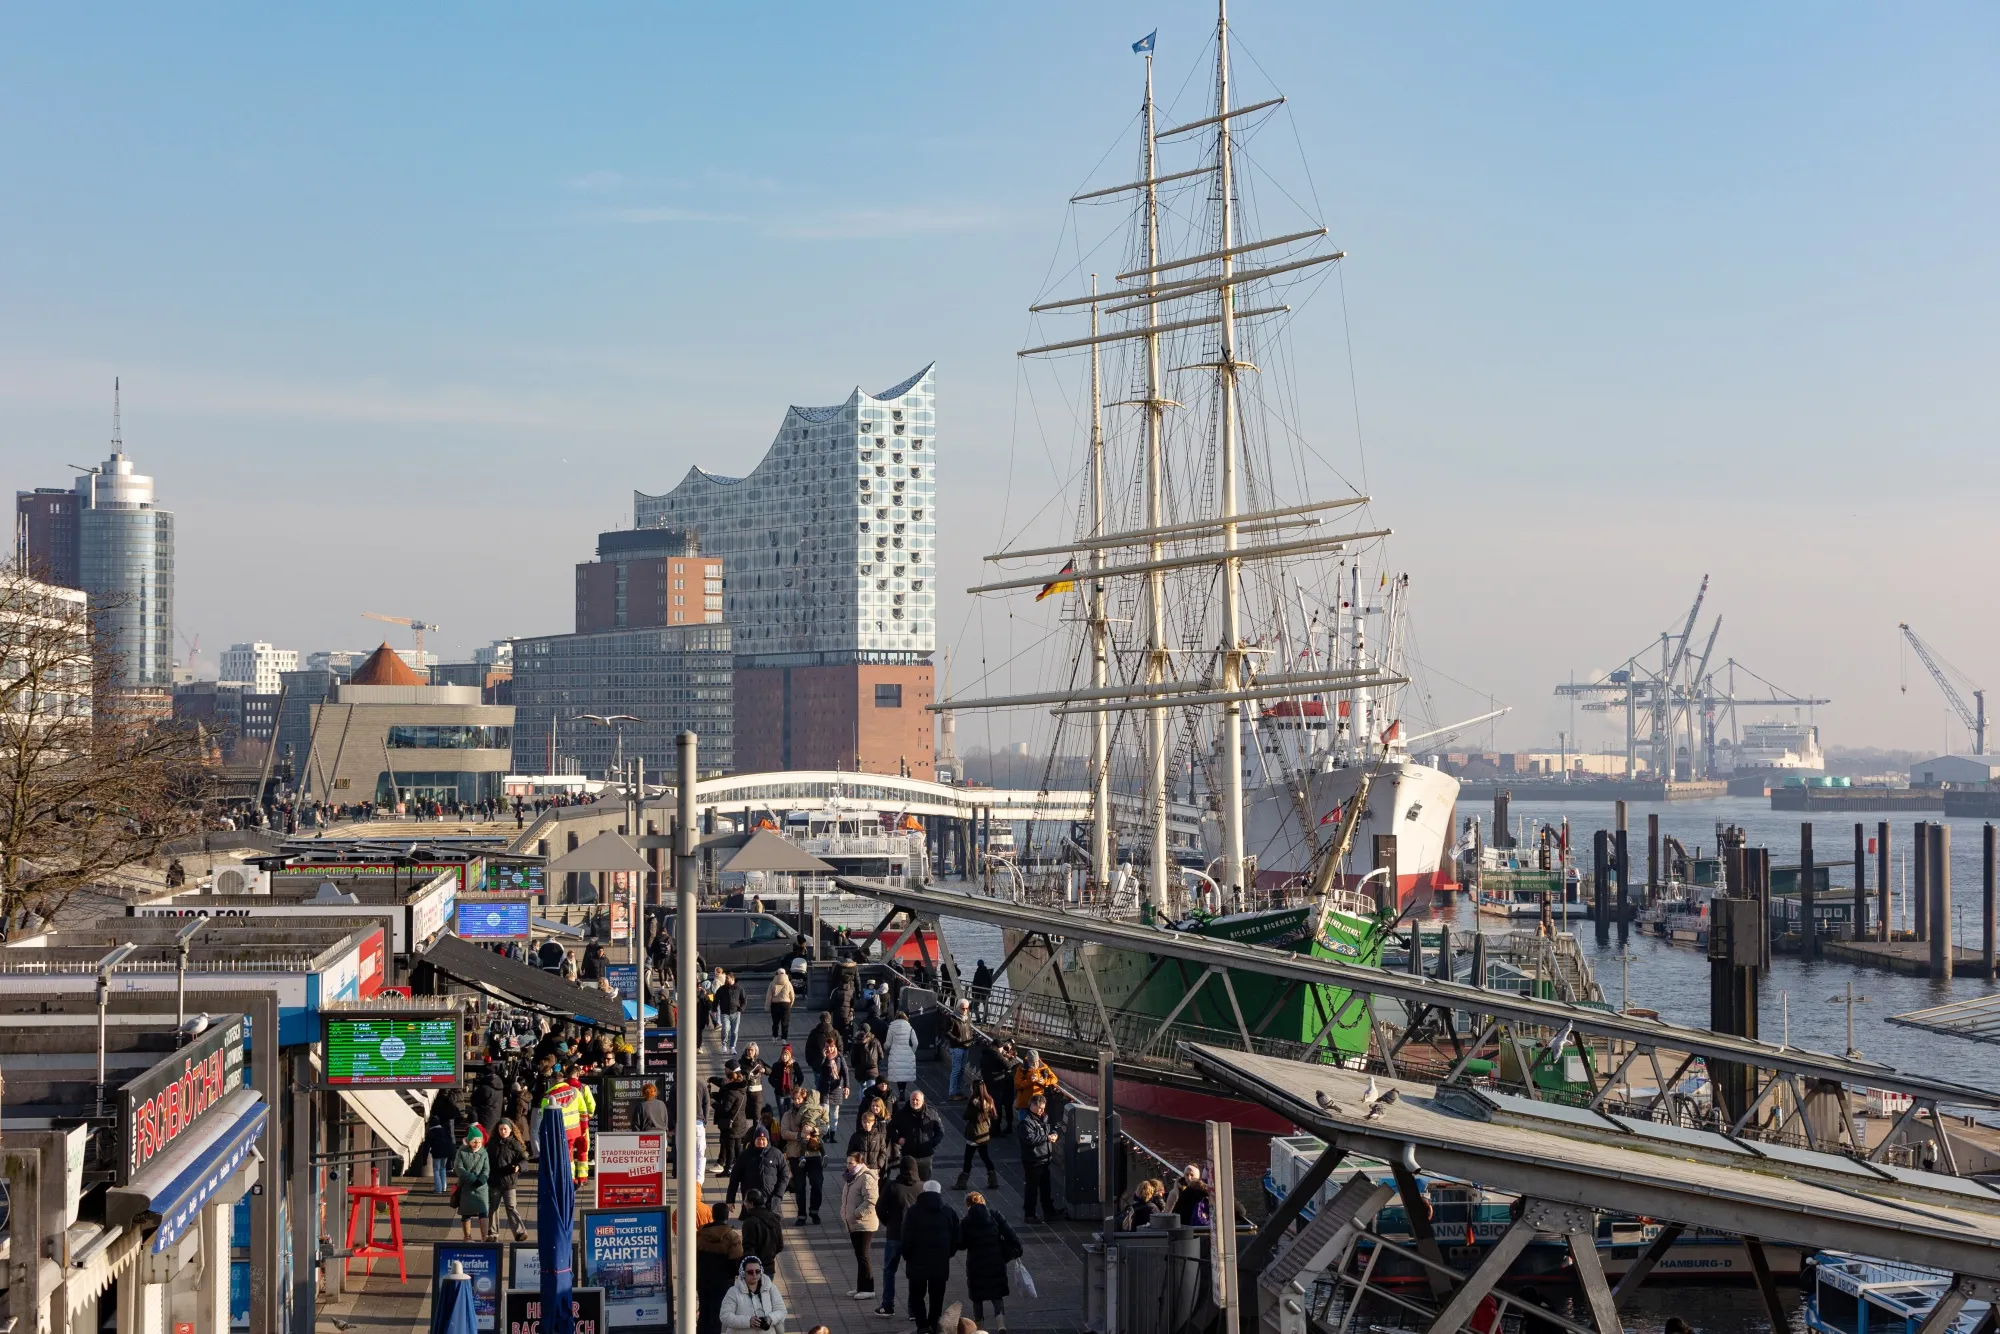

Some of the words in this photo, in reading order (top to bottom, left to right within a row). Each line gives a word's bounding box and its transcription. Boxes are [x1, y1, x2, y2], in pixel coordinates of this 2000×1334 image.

[1263, 916, 1297, 931] RICKMERS
[1230, 926, 1260, 939] RICKMER
[136, 1047, 224, 1169] FISCHBRÖTCHEN
[630, 1166, 655, 1176] HIER!
[594, 1236, 658, 1247] BARKASSEN
[596, 1247, 658, 1260] FAHRTEN
[1660, 1260, 1732, 1268] HAMBURG-D
[1817, 1268, 1836, 1286] RAINER
[1838, 1276, 1859, 1297] ABICHT
